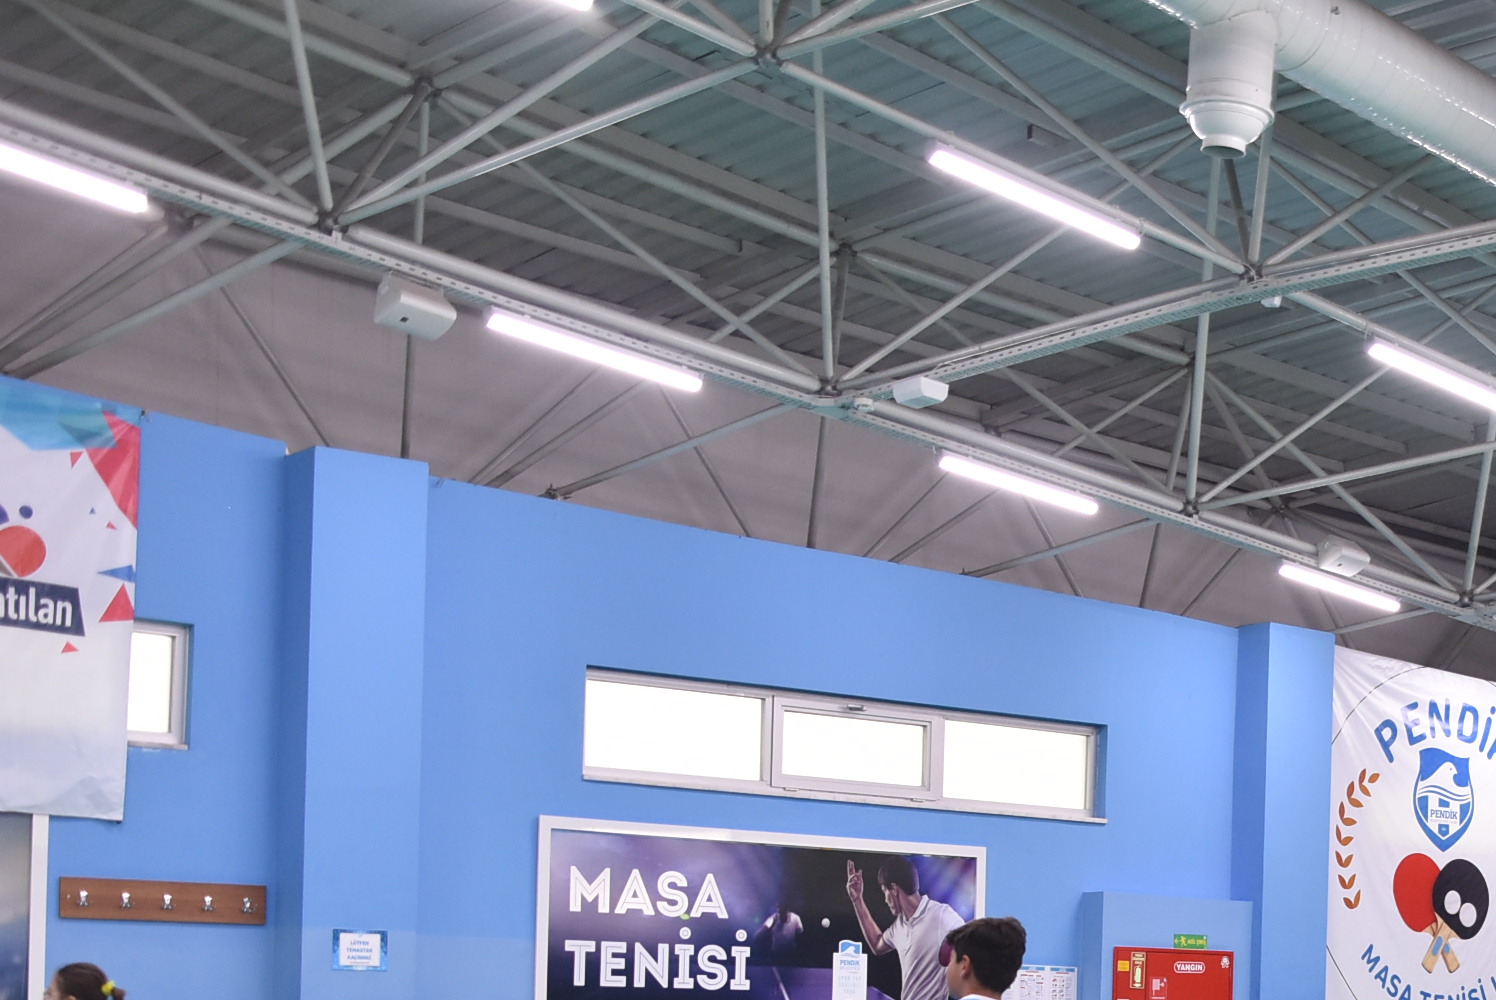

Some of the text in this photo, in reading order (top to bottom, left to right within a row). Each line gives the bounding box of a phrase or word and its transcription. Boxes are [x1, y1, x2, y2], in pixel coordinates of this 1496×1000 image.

[0, 586, 72, 627] tılan
[1430, 809, 1458, 819] PENDİK
[569, 865, 729, 919] MASA
[564, 926, 751, 990] TENİSİ
[1176, 963, 1203, 971] YANGIN
